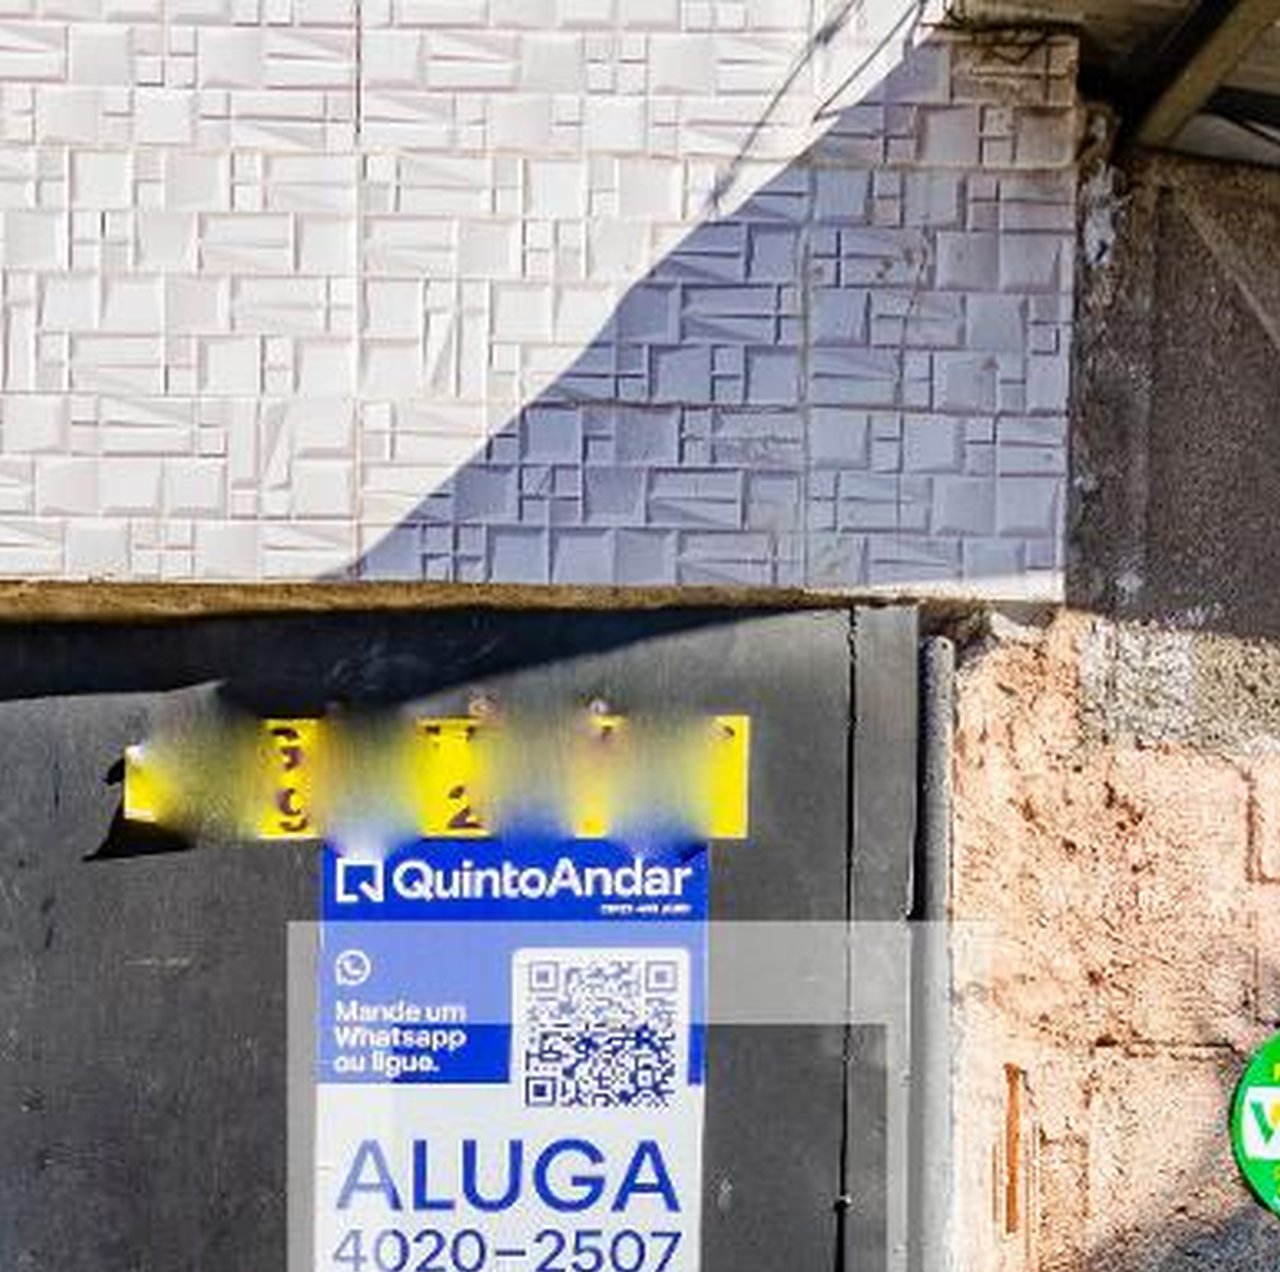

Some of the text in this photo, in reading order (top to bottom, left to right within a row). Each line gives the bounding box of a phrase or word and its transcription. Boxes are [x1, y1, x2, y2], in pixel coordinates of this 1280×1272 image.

[393, 857, 693, 902] QuintoAndar
[336, 1000, 468, 1022] Mande um
[335, 1025, 467, 1052] Whatsapp
[334, 1050, 440, 1077] ou ligue.
[336, 1138, 681, 1214] ALUGA
